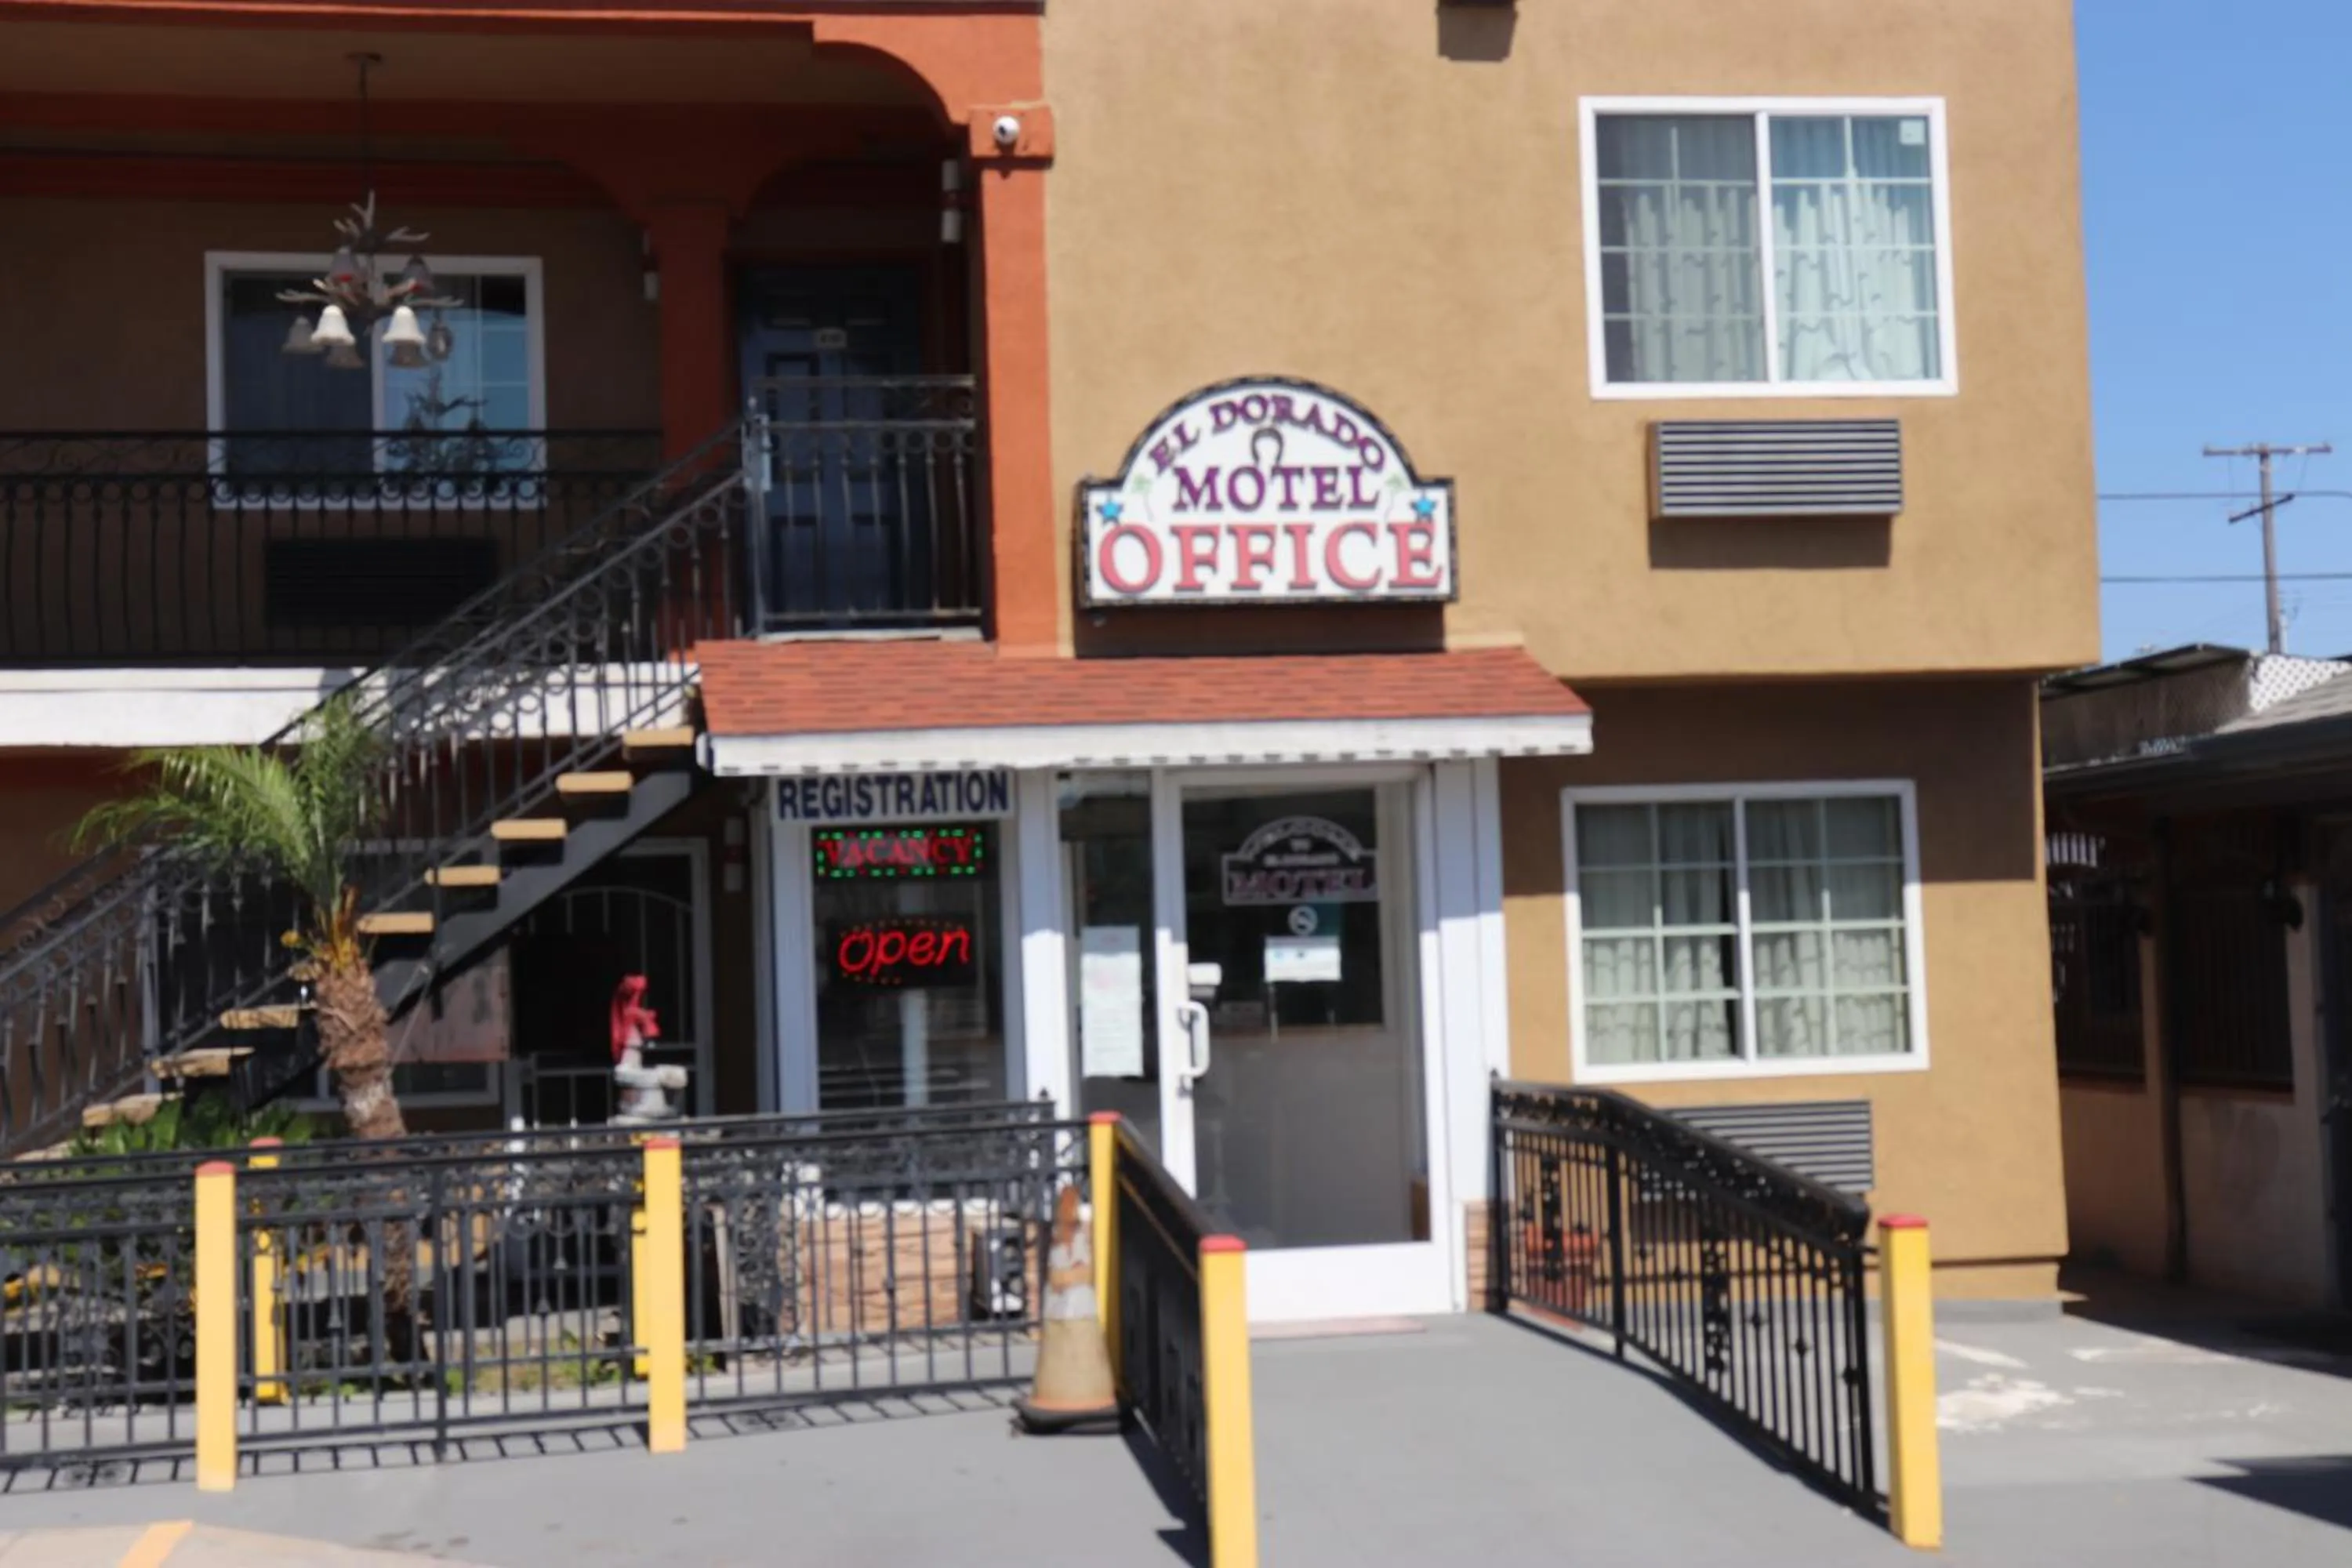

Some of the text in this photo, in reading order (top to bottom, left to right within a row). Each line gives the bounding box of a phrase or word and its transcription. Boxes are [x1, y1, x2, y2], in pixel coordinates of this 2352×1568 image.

[1149, 394, 1385, 474] EL DORADO
[1173, 467, 1377, 511] MOTEL
[1099, 522, 1443, 593] OFFICE
[778, 771, 1008, 819] REGISTRATION
[818, 837, 971, 866] VACANCY
